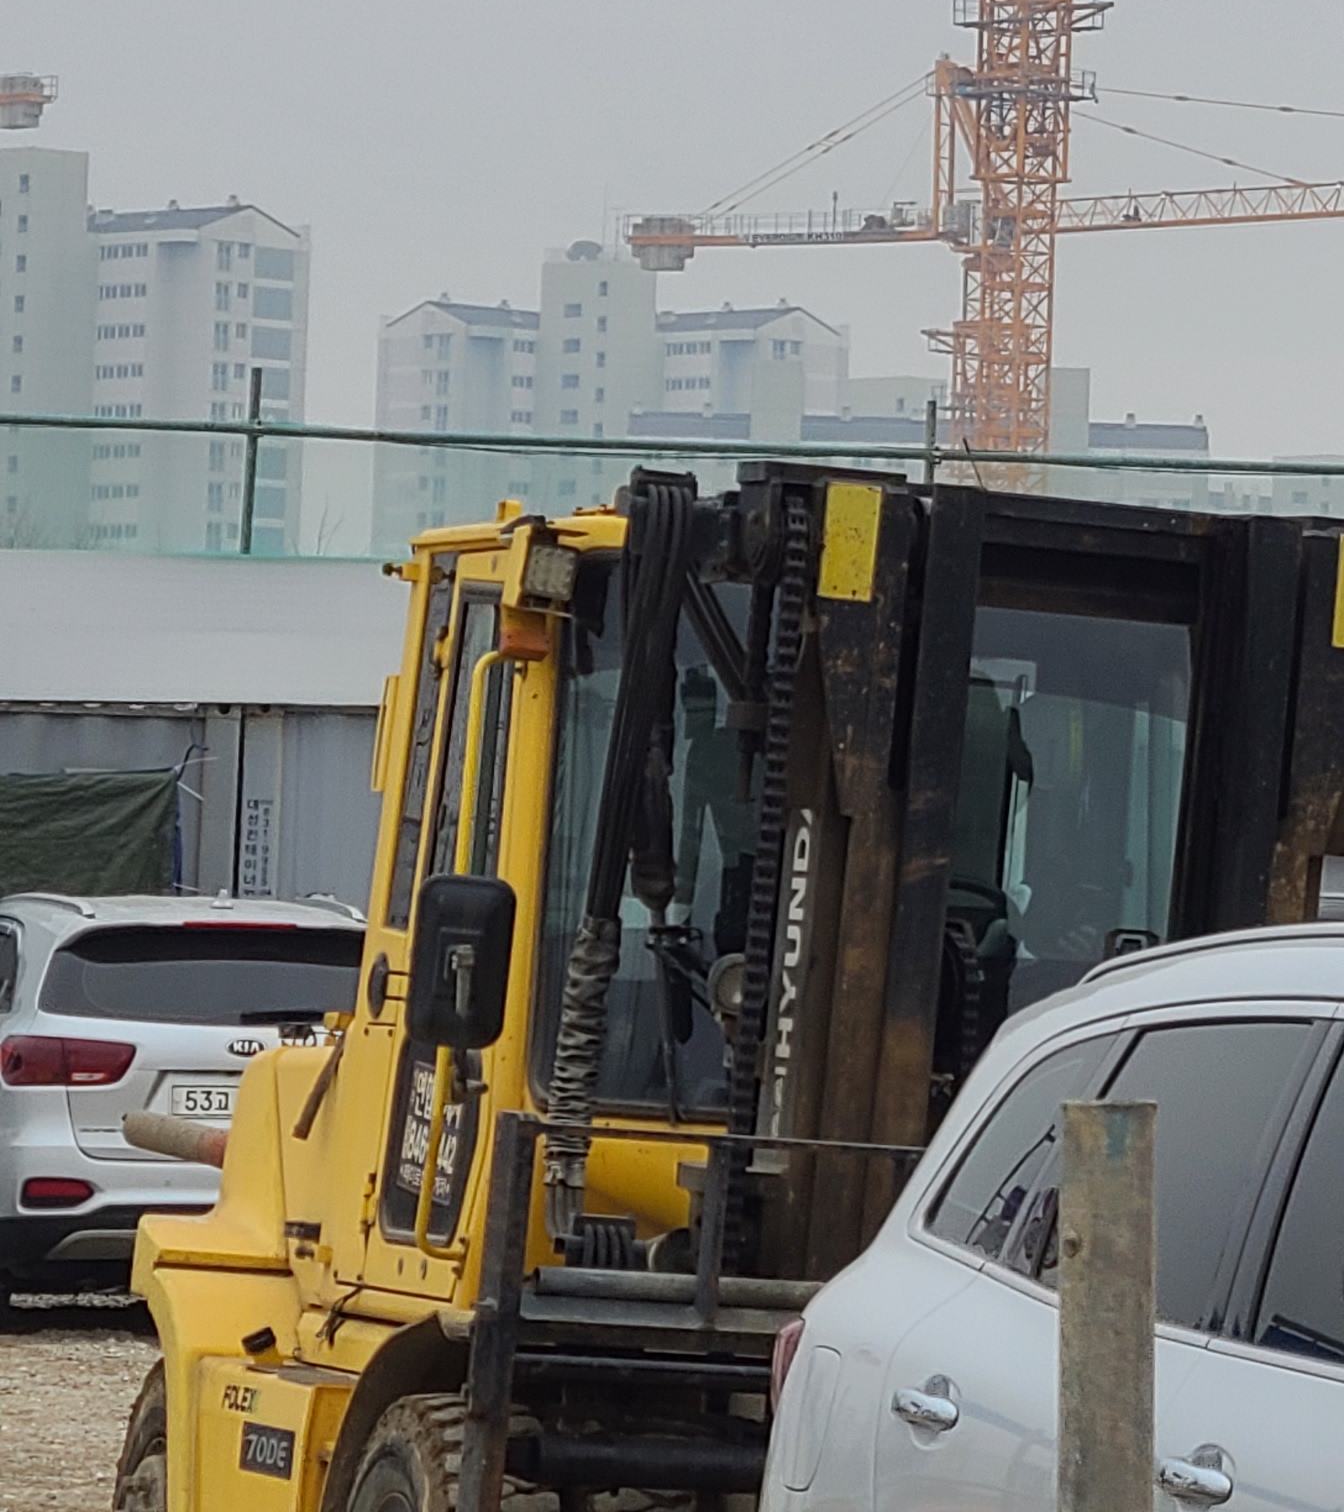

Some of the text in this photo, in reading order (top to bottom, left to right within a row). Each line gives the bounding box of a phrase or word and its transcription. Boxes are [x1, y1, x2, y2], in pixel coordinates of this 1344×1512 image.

[774, 808, 814, 1059] HYUND
[232, 1040, 261, 1054] KIA
[185, 1090, 230, 1112] 53고
